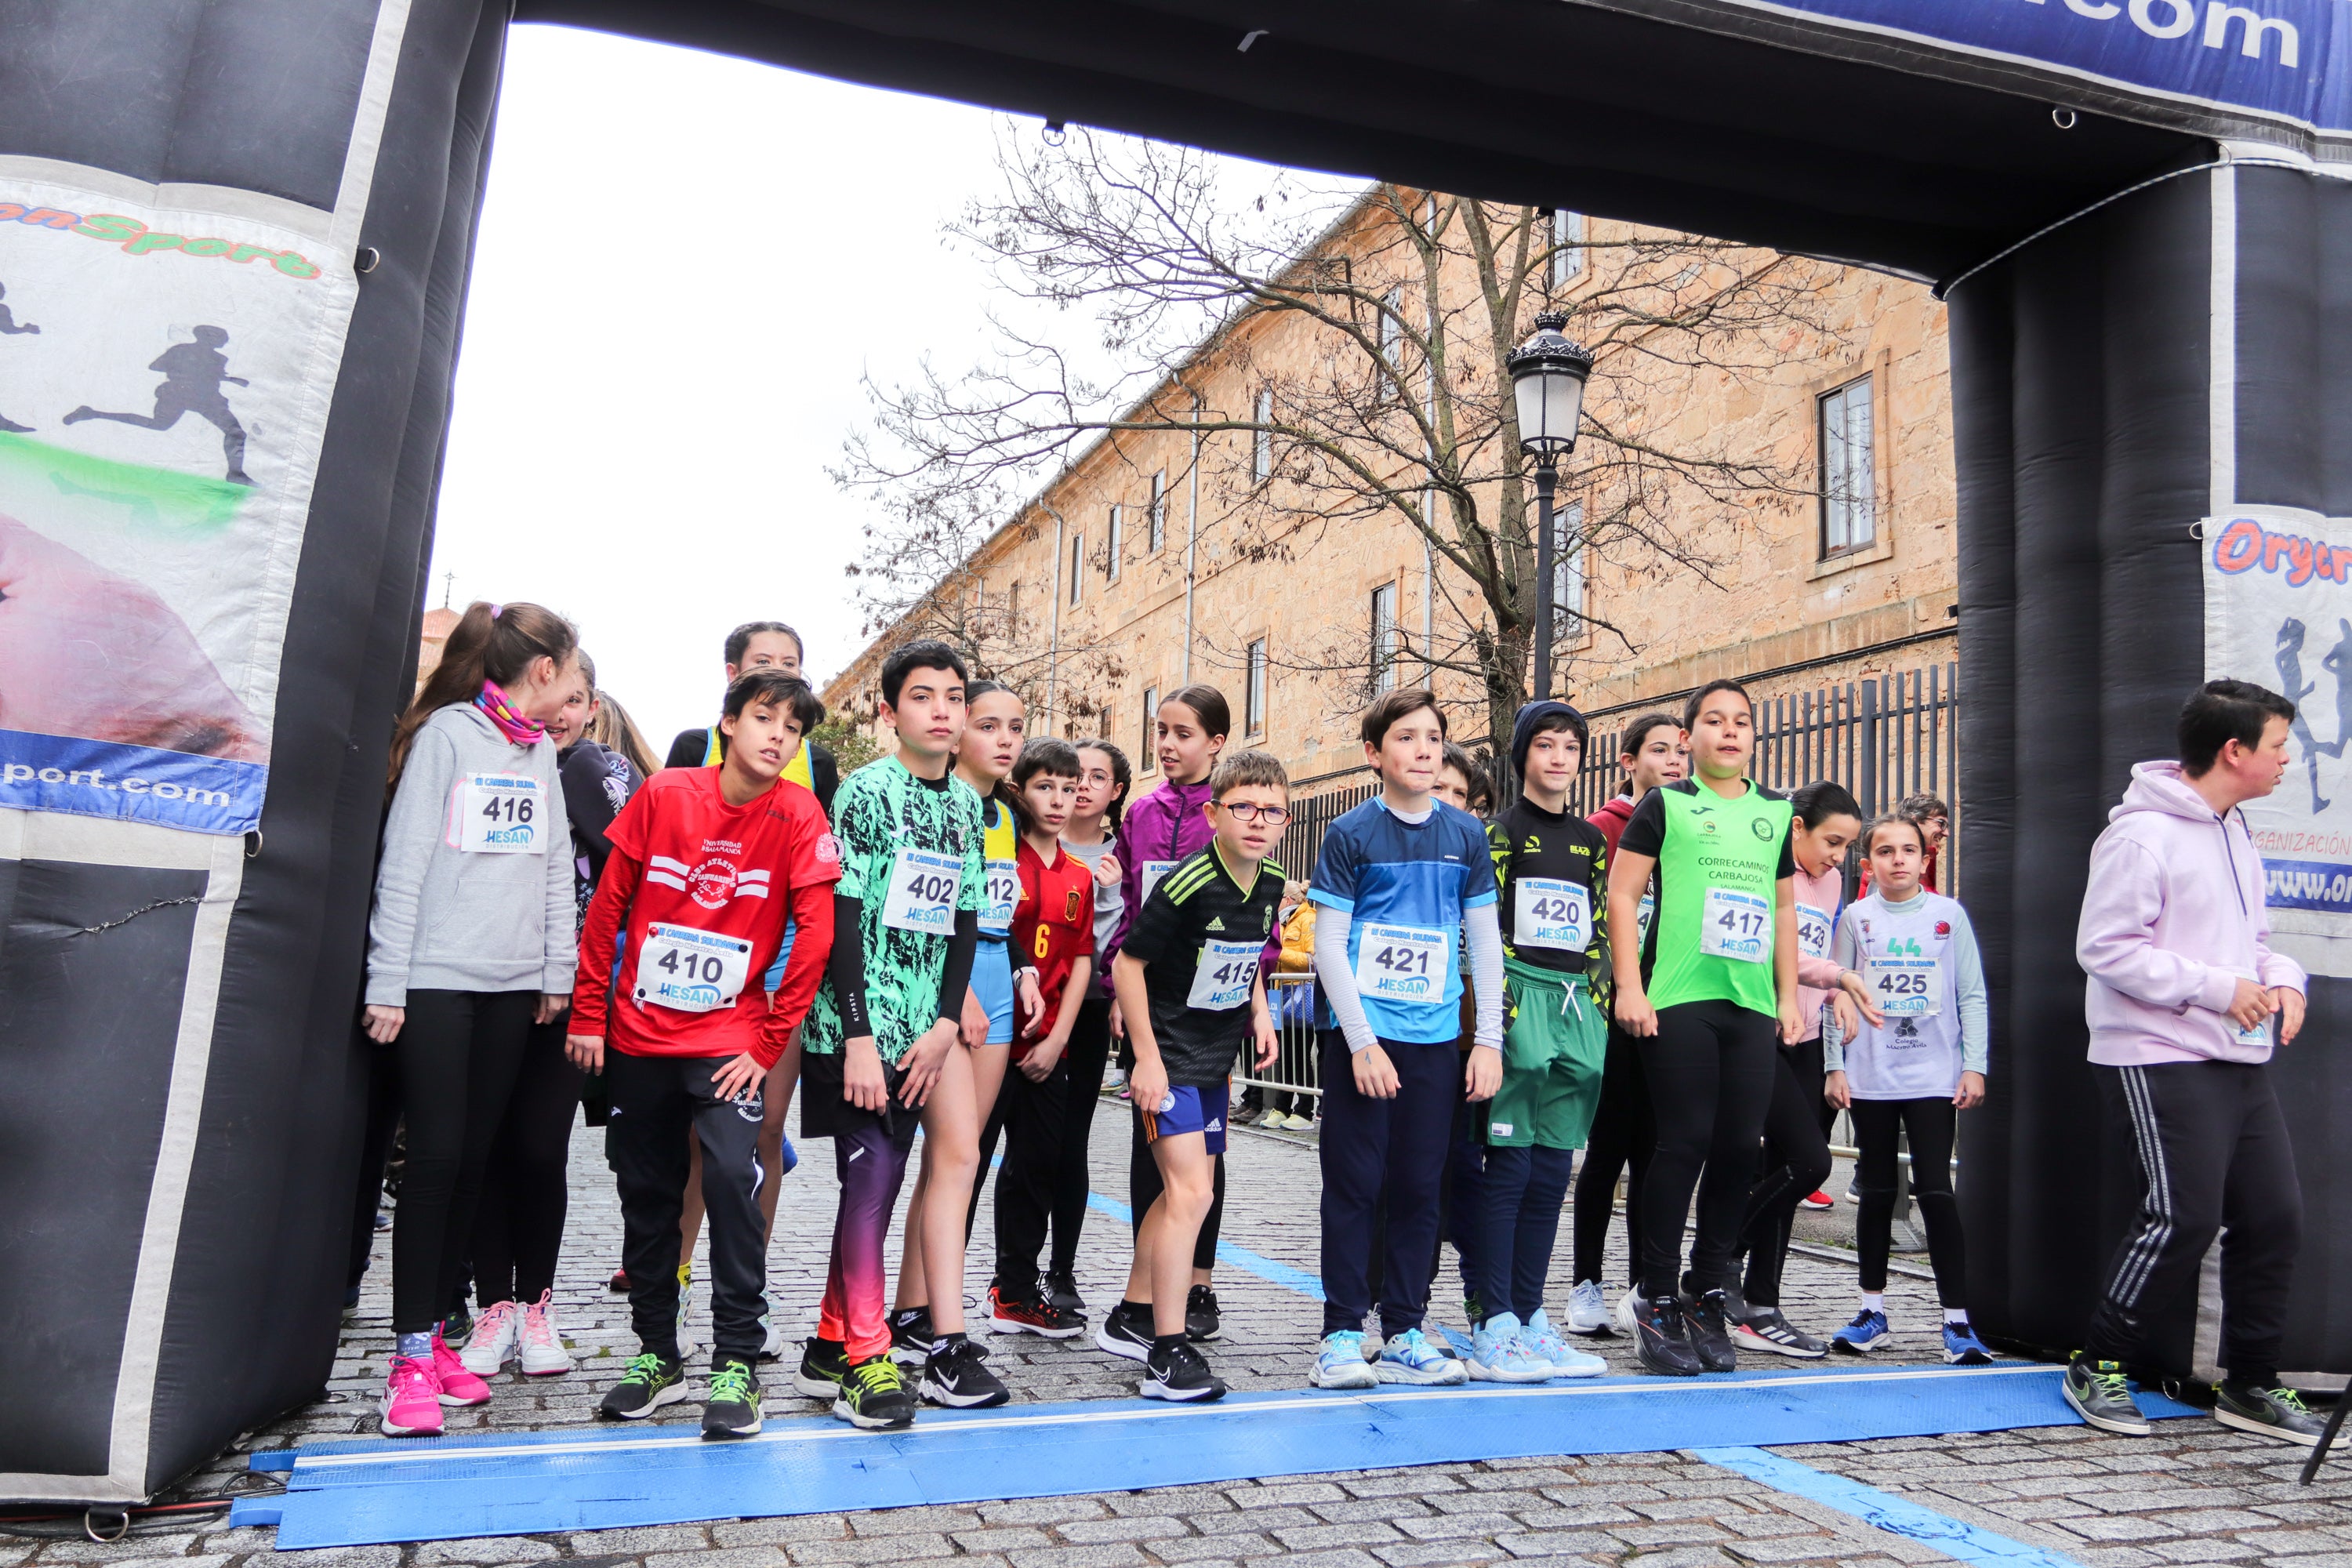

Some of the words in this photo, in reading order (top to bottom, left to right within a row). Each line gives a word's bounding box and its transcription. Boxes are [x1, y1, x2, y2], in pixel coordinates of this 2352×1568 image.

[2025, 0, 2298, 69] om
[3, 763, 230, 808] port.com
[483, 797, 533, 823] 416
[483, 830, 529, 844] HESAN
[2234, 818, 2350, 856] RGANIZACIÓN
[1698, 857, 1769, 875] CORRECAMINOS
[1708, 871, 1763, 885] CARBAJOSA
[907, 873, 953, 903] 402
[989, 877, 1014, 901] 12
[1720, 884, 1756, 892] SALAMANCA
[902, 907, 946, 925] HESAN
[1531, 898, 1579, 924] 420
[1719, 909, 1763, 936] 417
[666, 929, 699, 943] CARRERA
[1034, 924, 1050, 958] 6
[1380, 929, 1410, 939] CARRERA
[1533, 927, 1577, 942] HESAN
[1798, 923, 1825, 949] 423
[659, 938, 684, 948] Colegio
[684, 942, 713, 953] Maestro
[1719, 938, 1757, 955] HESAN
[1887, 938, 1922, 956] 44
[658, 949, 723, 983] 410
[1375, 946, 1428, 974] 421
[1213, 962, 1256, 985] 415
[1374, 978, 1425, 994] HESAN
[1878, 974, 1927, 993] 425
[655, 982, 714, 1004] HESAN
[1377, 989, 1424, 1000] DISTRIBUCIÓN
[1882, 1000, 1924, 1011] HESAN
[901, 1311, 918, 1321] NIKE
[933, 1338, 948, 1348] NIKE
